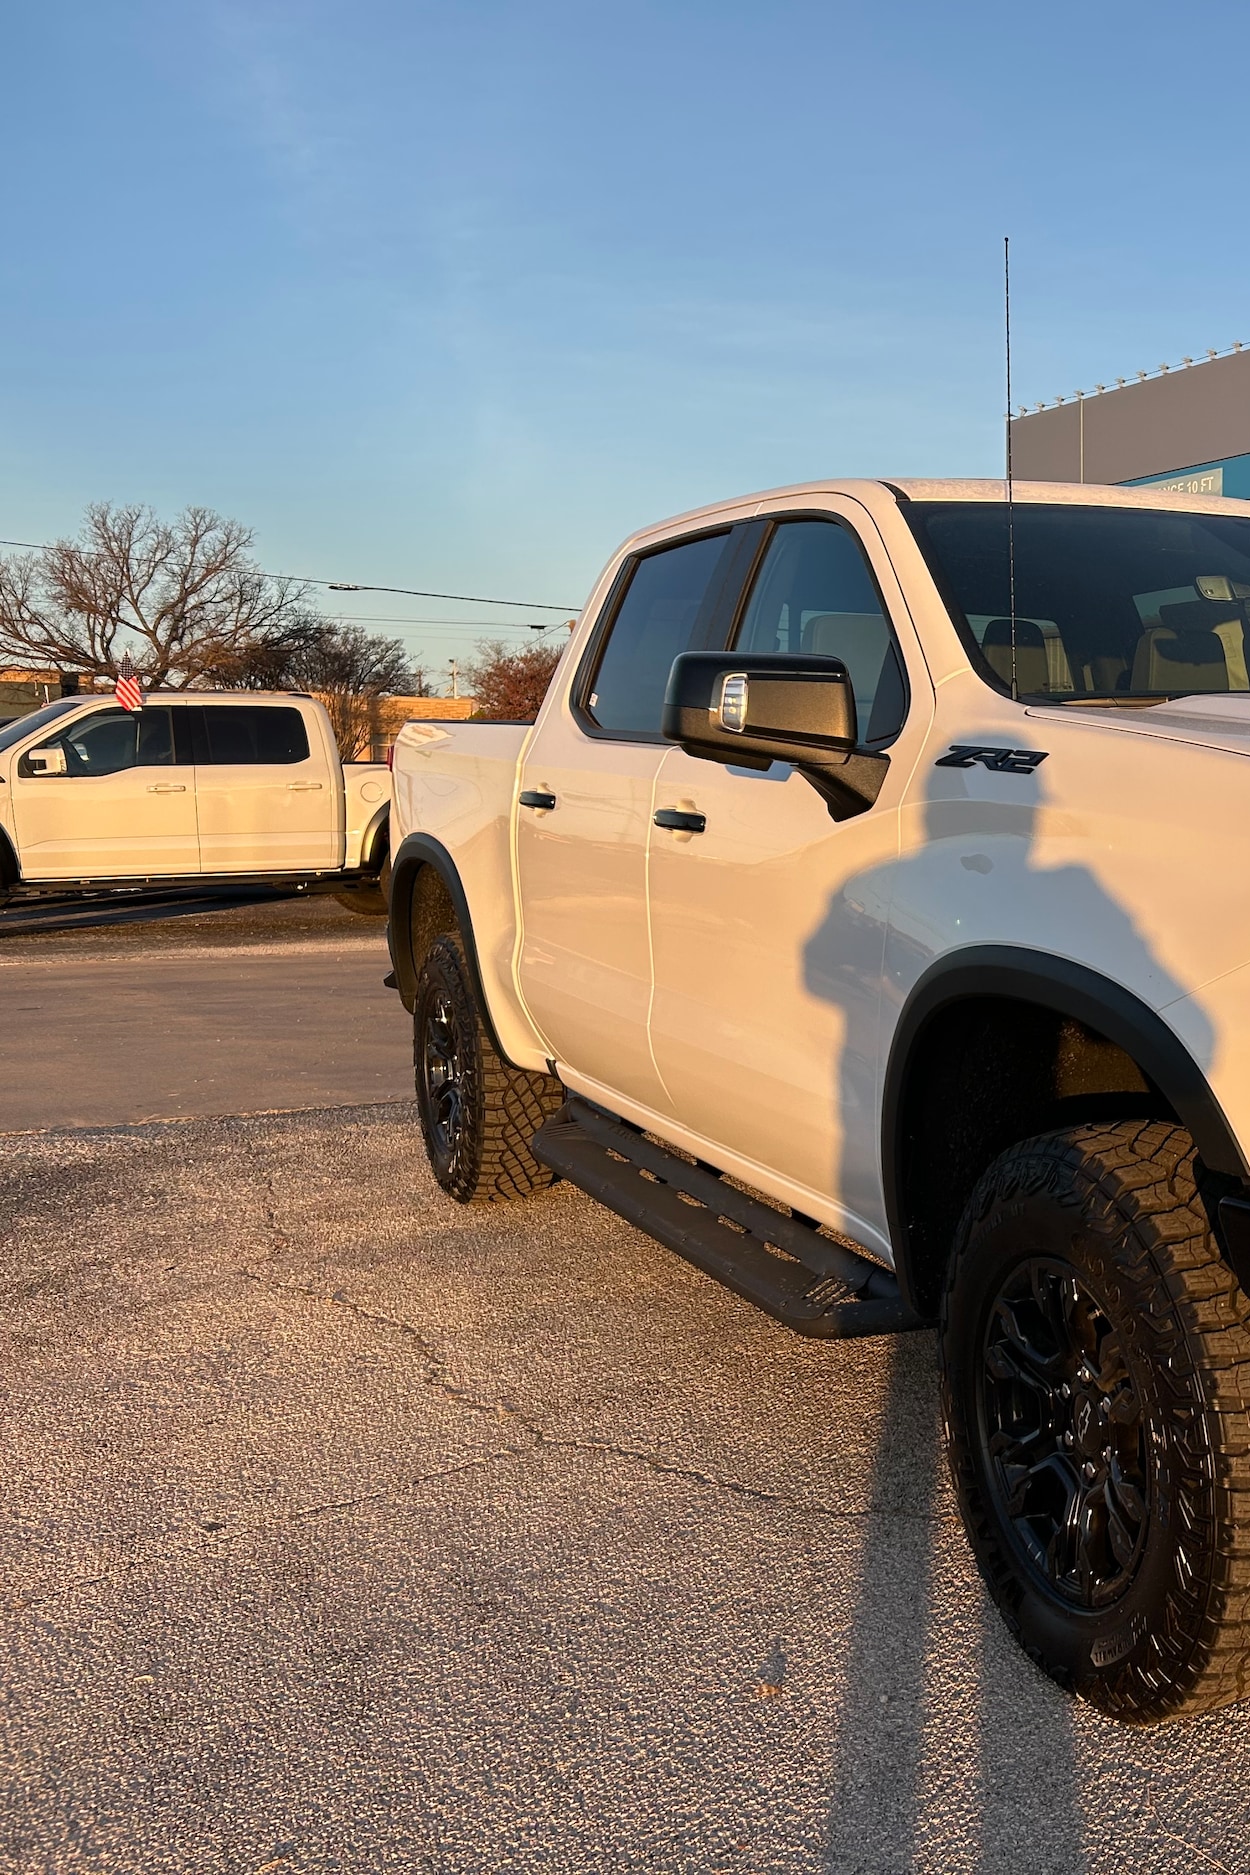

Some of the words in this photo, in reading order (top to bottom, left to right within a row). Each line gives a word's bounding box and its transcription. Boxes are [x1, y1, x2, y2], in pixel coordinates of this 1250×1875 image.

[1187, 480, 1198, 494] 10
[1201, 476, 1214, 492] FT
[934, 744, 1050, 775] ZR2
